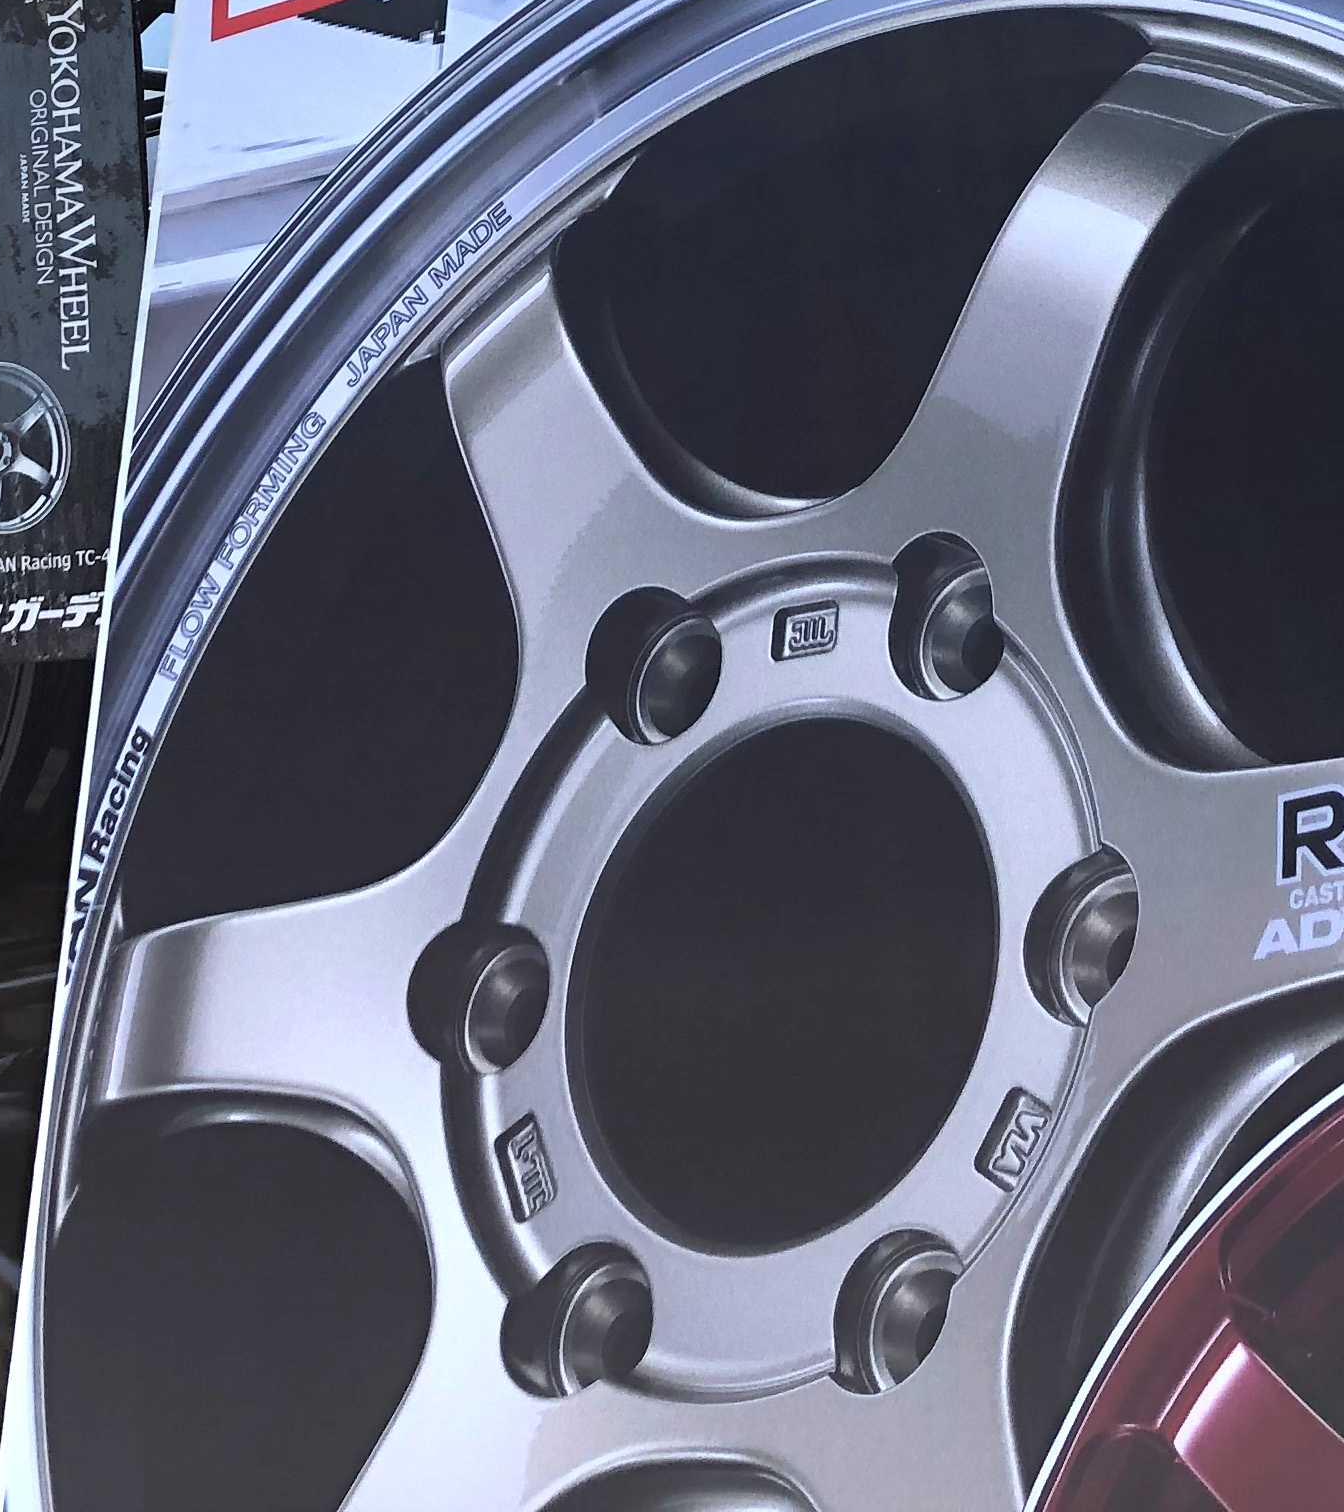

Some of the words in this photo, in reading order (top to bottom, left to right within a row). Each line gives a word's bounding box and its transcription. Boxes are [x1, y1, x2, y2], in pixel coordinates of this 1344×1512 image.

[20, 153, 29, 189] JAPAN
[29, 89, 51, 197] ORIGINAL
[21, 192, 31, 224] MADE
[34, 202, 55, 286] DESIGN
[345, 282, 429, 389] JAPAN
[426, 202, 513, 291] MADE
[21, 553, 71, 573] Racing
[158, 576, 223, 682] FLOW
[214, 410, 330, 574] FORMING
[85, 724, 154, 865] Racing
